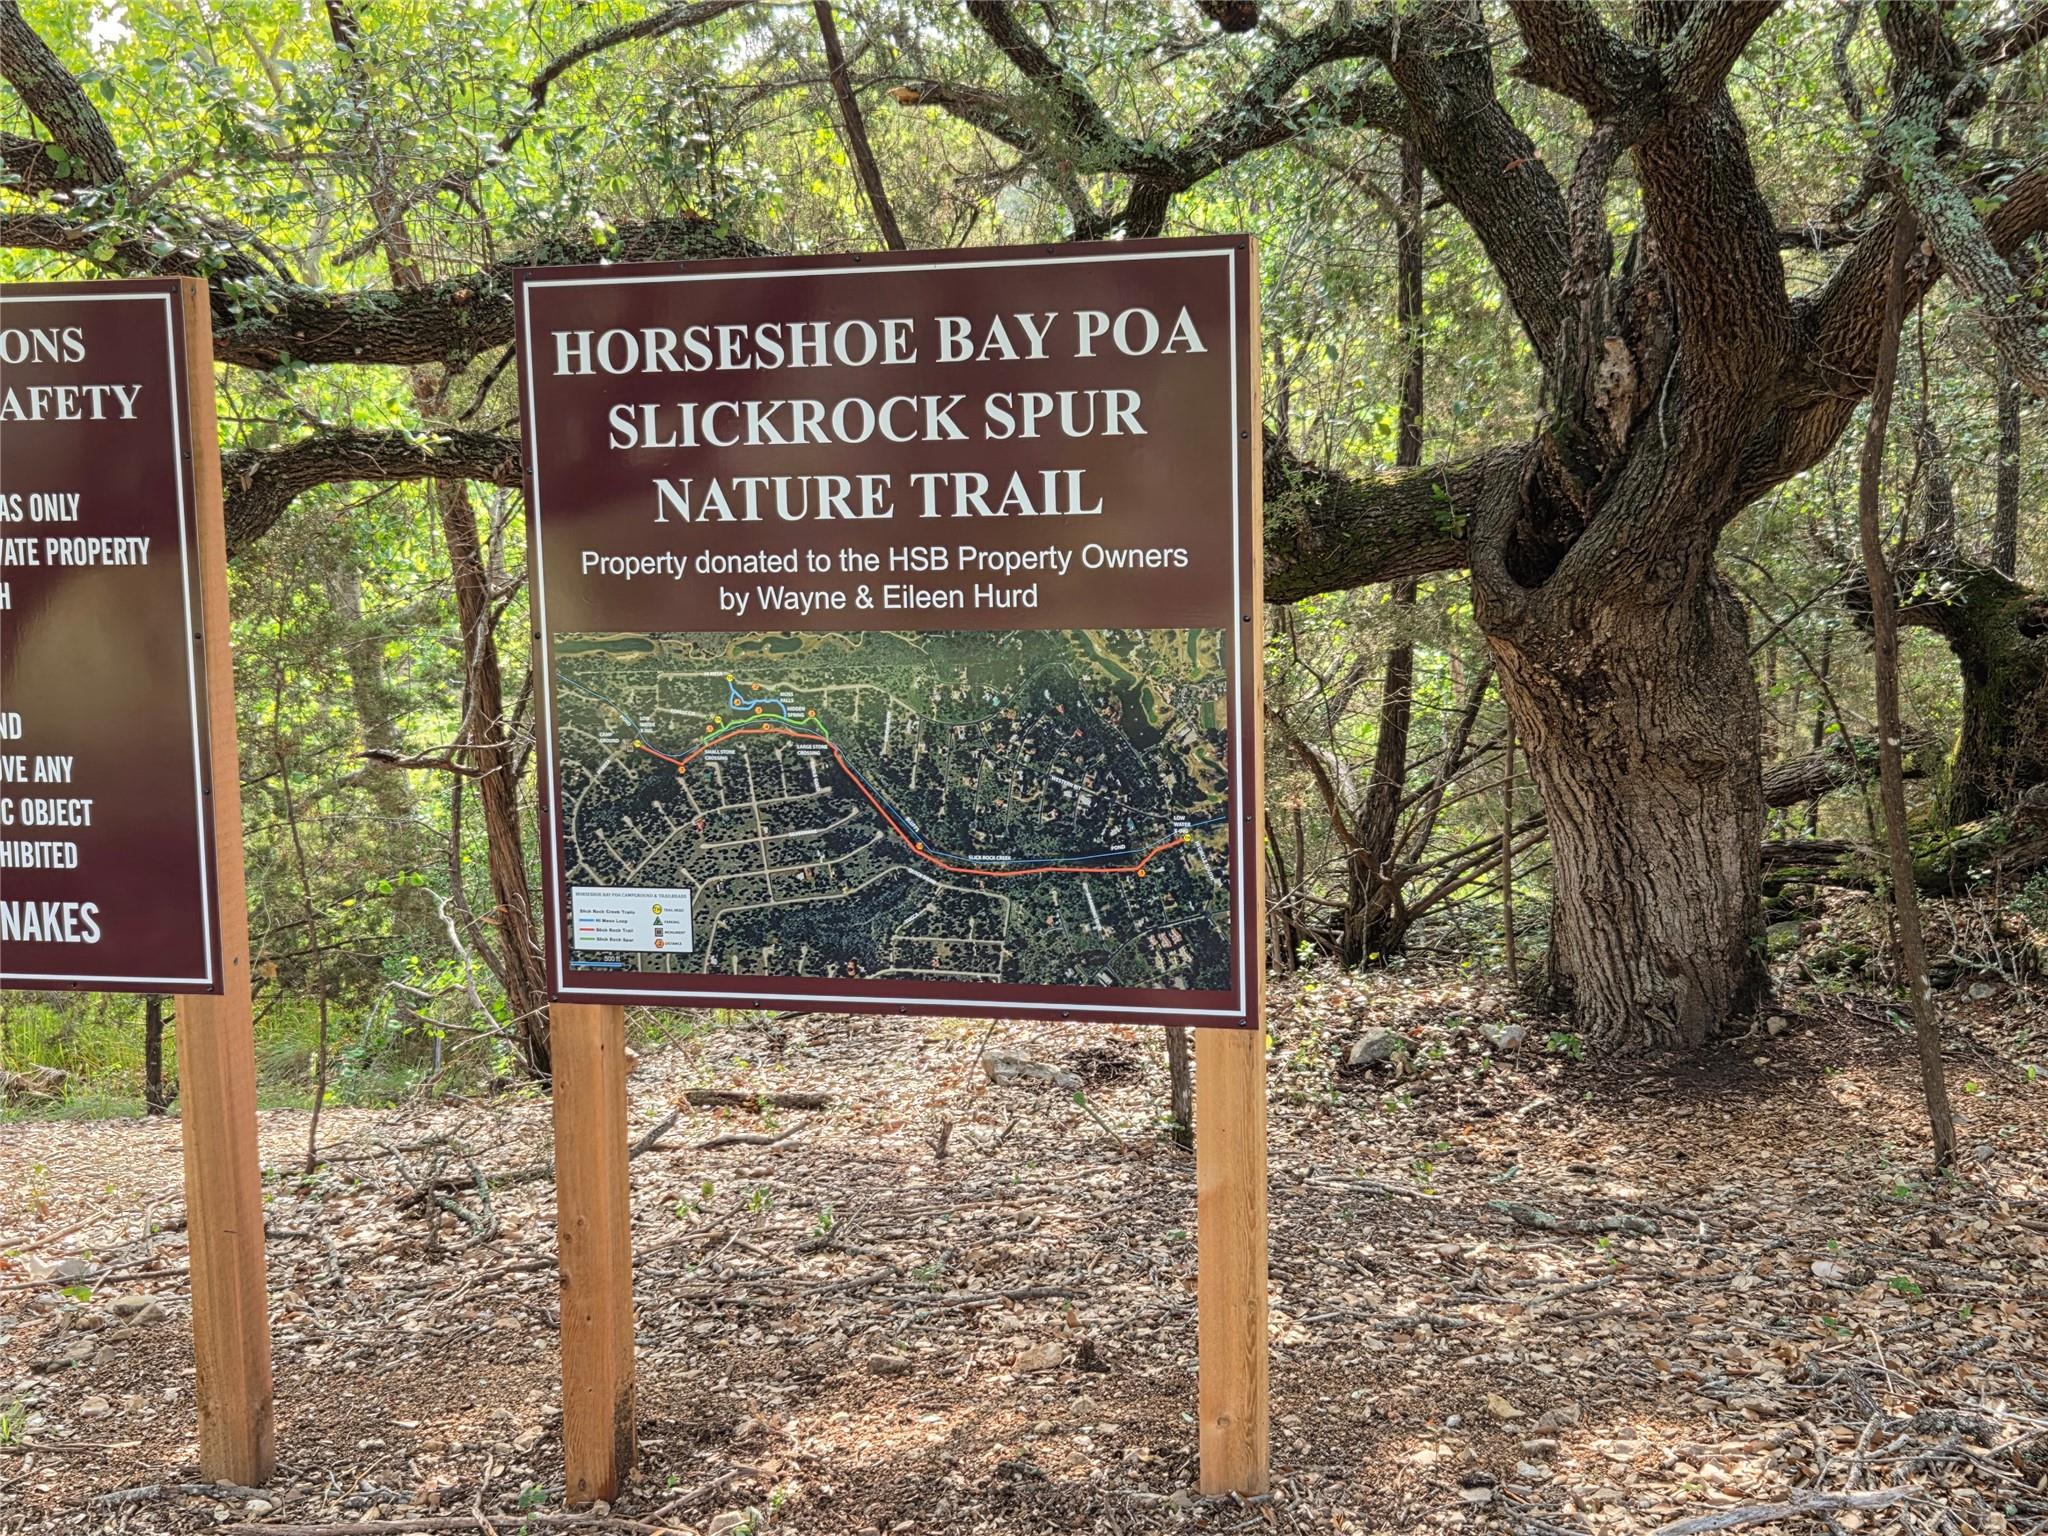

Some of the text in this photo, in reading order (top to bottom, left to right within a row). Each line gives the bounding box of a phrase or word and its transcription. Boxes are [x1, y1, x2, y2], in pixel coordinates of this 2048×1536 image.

[0, 328, 86, 364] ONS
[551, 305, 1208, 377] HORSESHOE BAY POA
[0, 384, 144, 421] AFETY
[609, 389, 1148, 450] SLICKROCK SPUR
[29, 493, 81, 523] ONLY
[652, 469, 1103, 523] NATURE TRAIL
[0, 537, 150, 566] ATE PROPERTY
[582, 543, 1189, 581] Property donated to the HSB Property Owners
[719, 582, 1038, 616] by Wayne & Eileen Hurd
[0, 755, 74, 783] VE ANY
[0, 798, 93, 827] C OBJECT
[0, 840, 79, 869] HIBITED
[0, 901, 101, 944] NAKES
